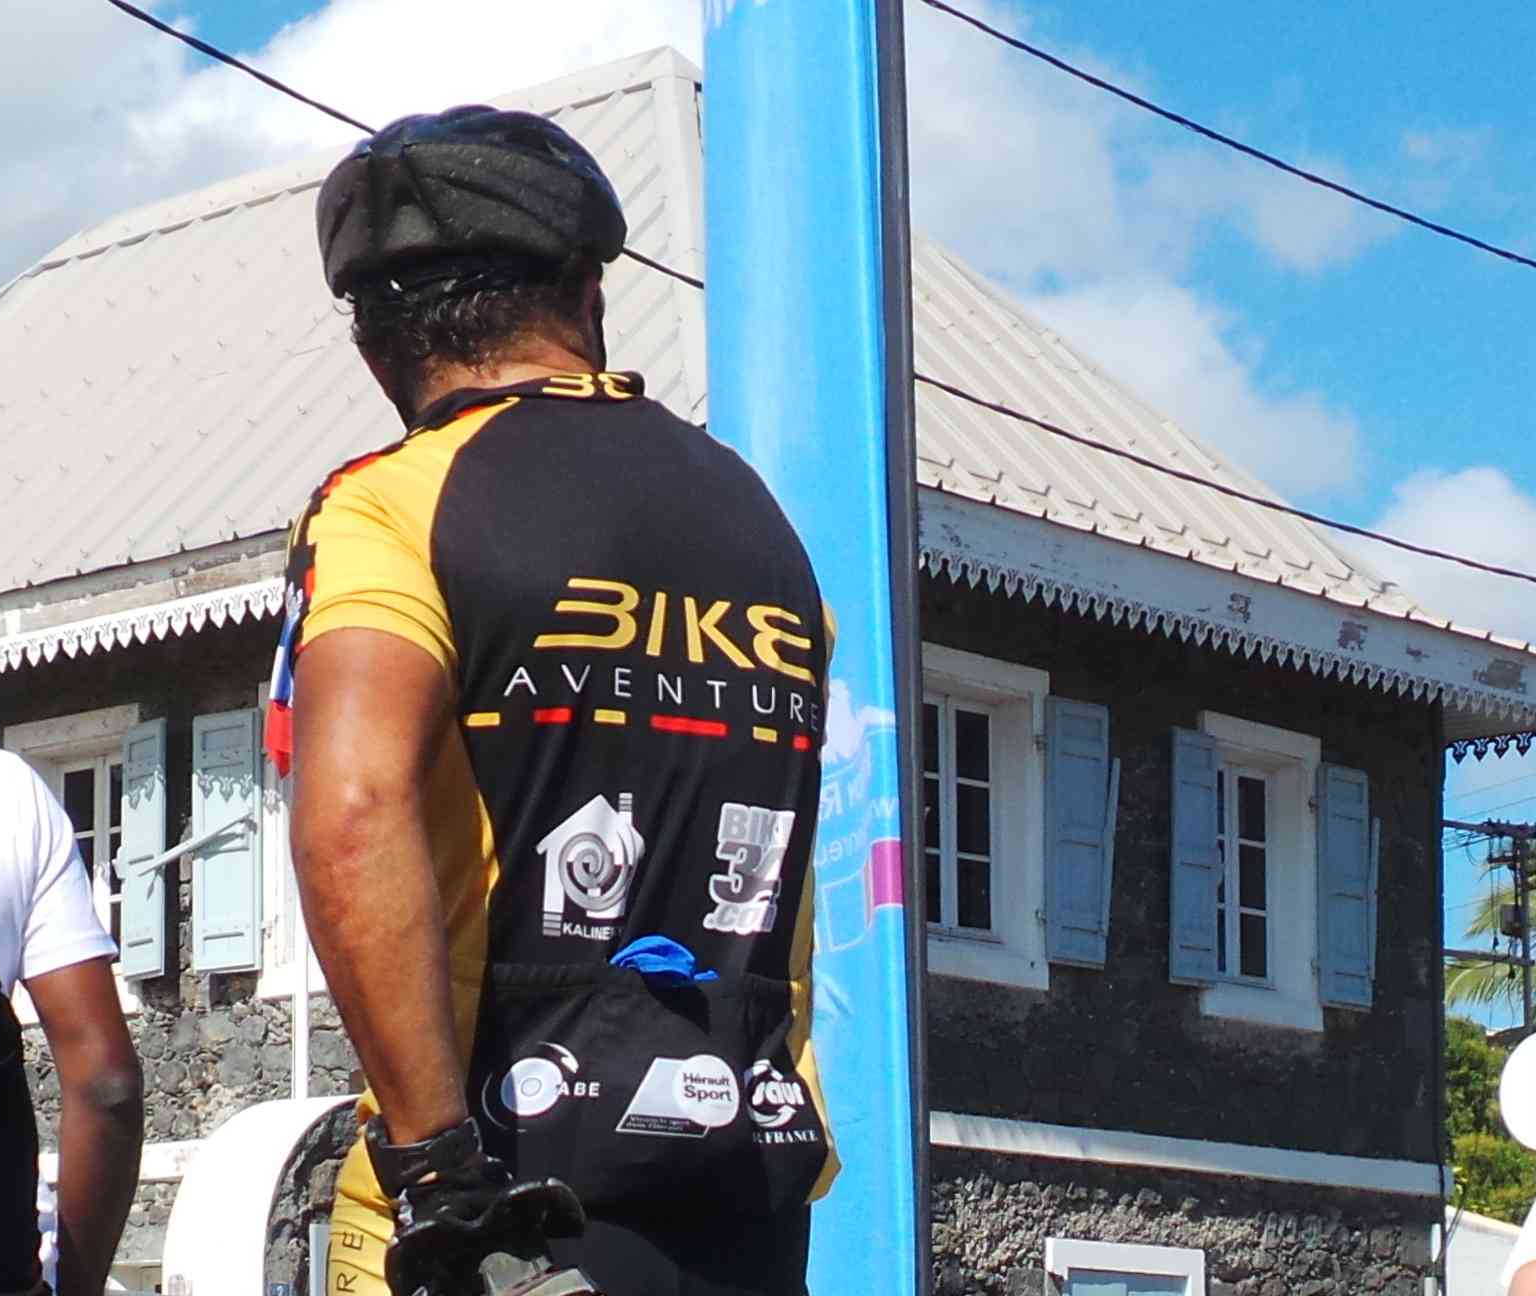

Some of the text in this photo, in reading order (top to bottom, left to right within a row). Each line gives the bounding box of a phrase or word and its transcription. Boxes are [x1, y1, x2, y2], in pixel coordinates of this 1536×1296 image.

[533, 577, 816, 687] BIKE
[504, 663, 820, 732] AVENTURE
[683, 1072, 730, 1087] Hérault
[684, 1085, 732, 1102] Sport
